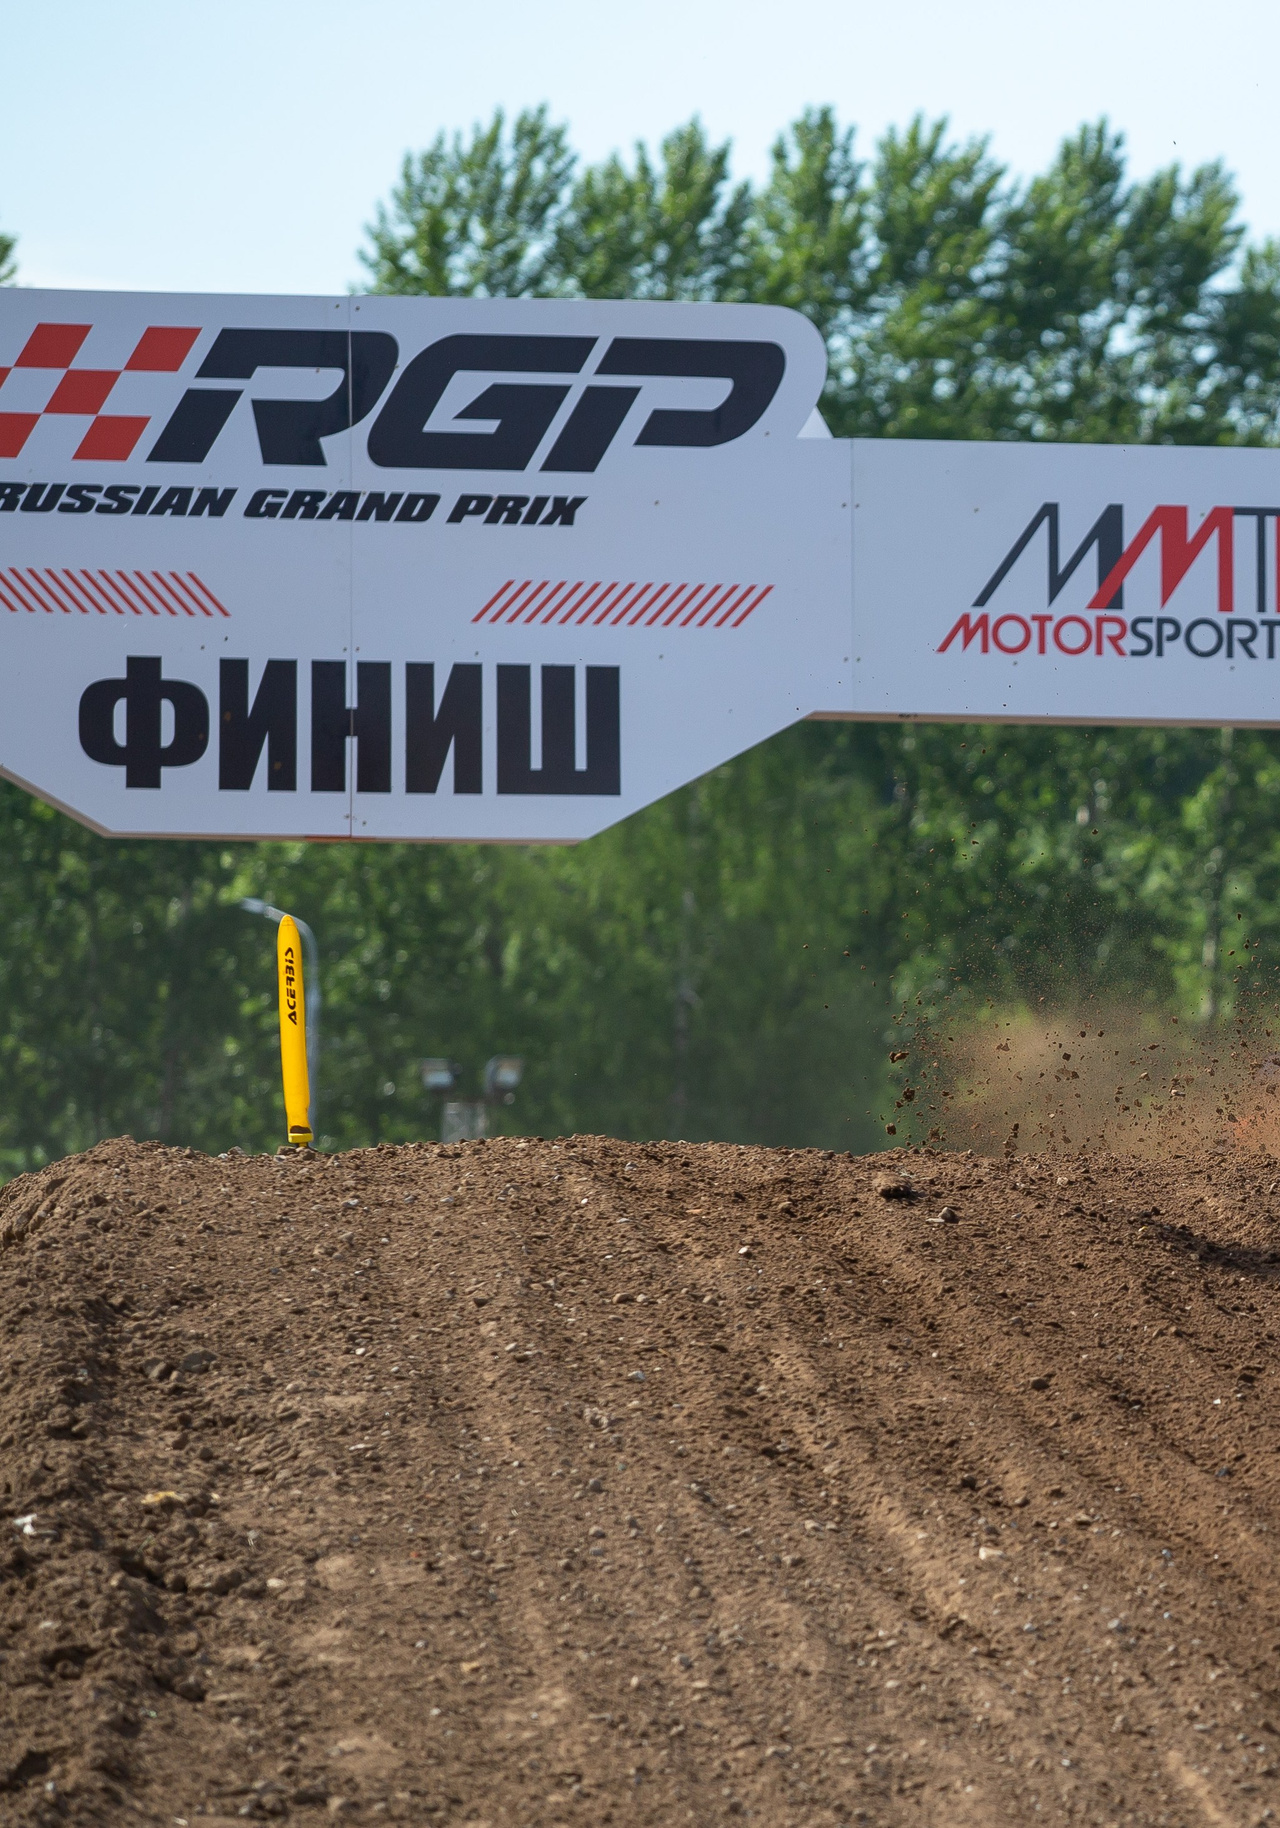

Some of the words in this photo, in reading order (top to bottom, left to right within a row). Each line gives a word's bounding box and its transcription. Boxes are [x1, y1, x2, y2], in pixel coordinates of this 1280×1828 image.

[146, 327, 787, 473] RGP
[0, 482, 238, 517] RUSSIAN
[243, 489, 441, 522] GRAND
[446, 495, 589, 526] PRIX
[78, 655, 622, 796] ФИНИШ
[285, 947, 297, 1025] ACERBIS
